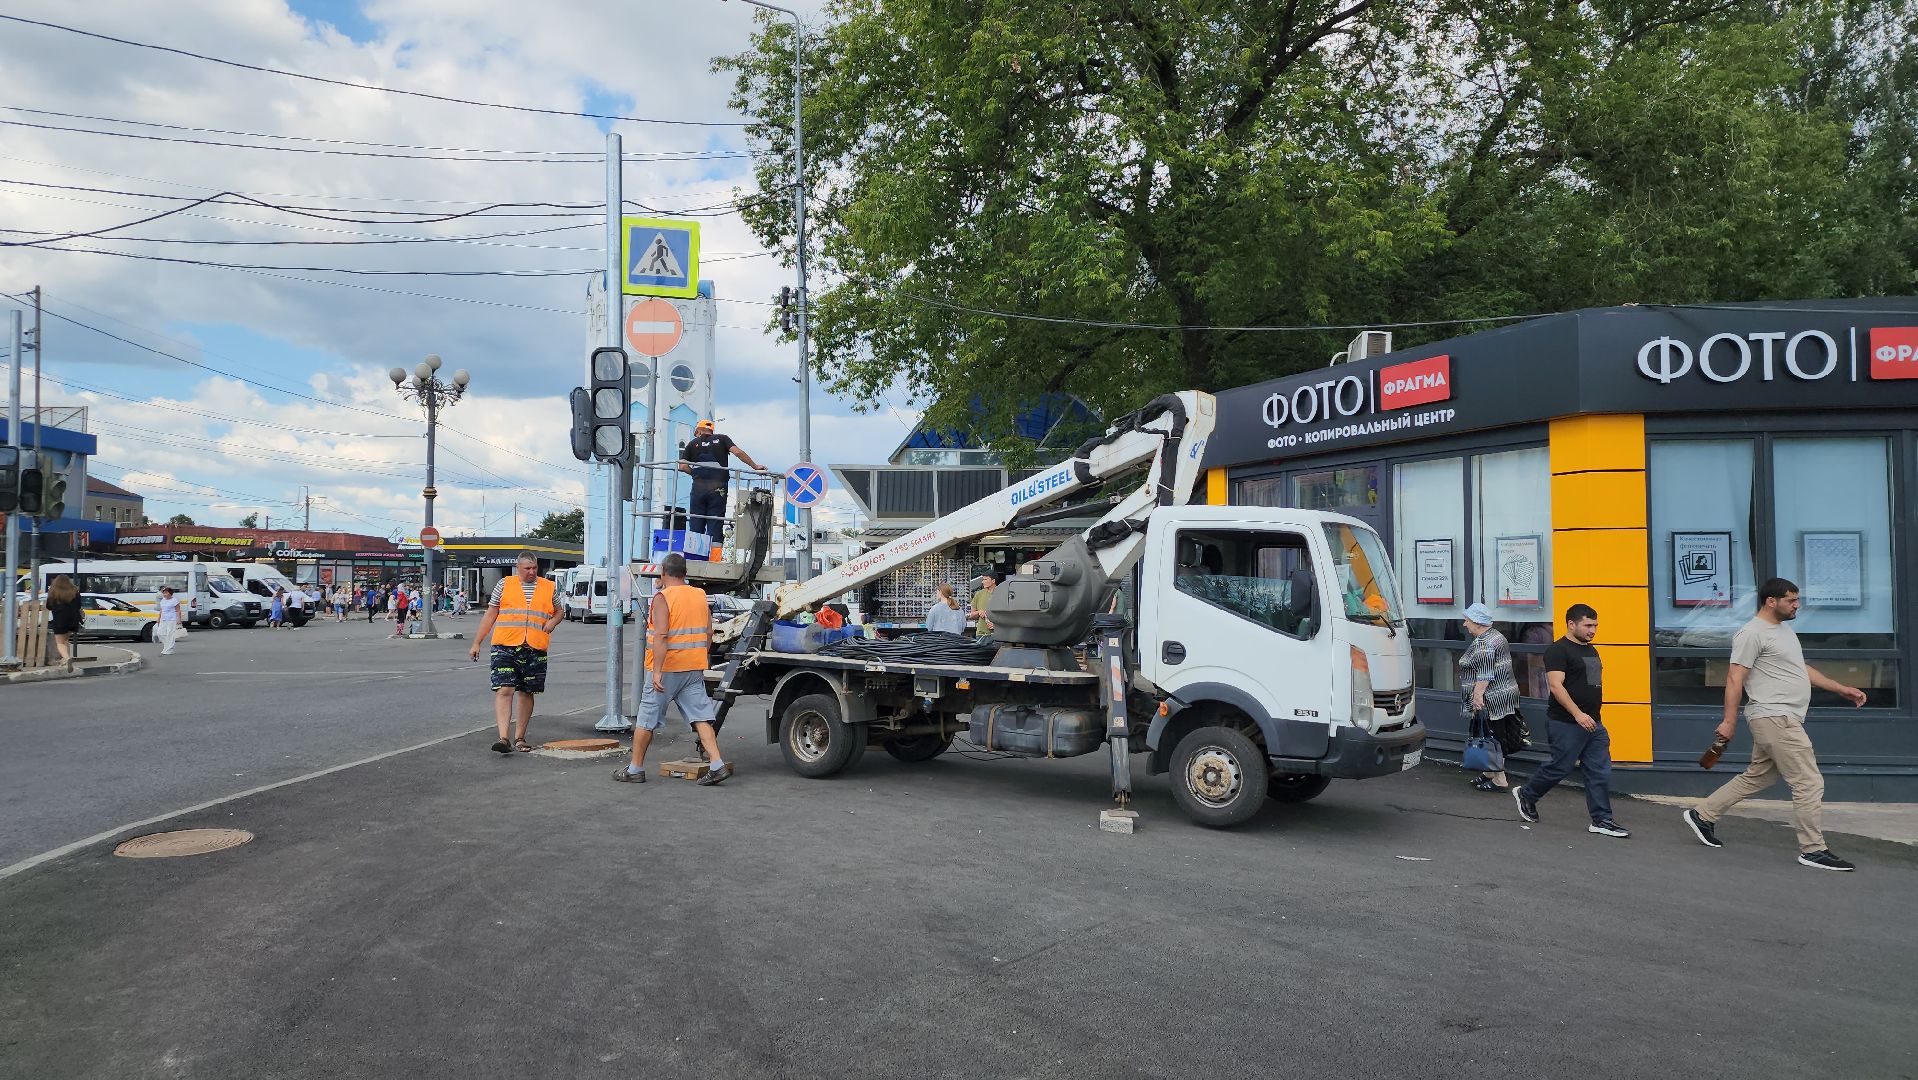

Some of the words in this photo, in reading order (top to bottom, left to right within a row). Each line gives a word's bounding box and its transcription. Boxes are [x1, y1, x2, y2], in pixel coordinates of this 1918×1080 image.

[1637, 329, 1838, 384] ФОТО
[1262, 375, 1364, 428] ФОТО
[1383, 371, 1447, 395] ФРАГМА
[1267, 433, 1297, 449] ФОТО
[1304, 413, 1411, 444] КОПИРОВАЛЬНЫЙ
[1414, 408, 1455, 428] ЦЕНТР
[173, 535, 254, 546] СКУПКА-РЕМОНТ
